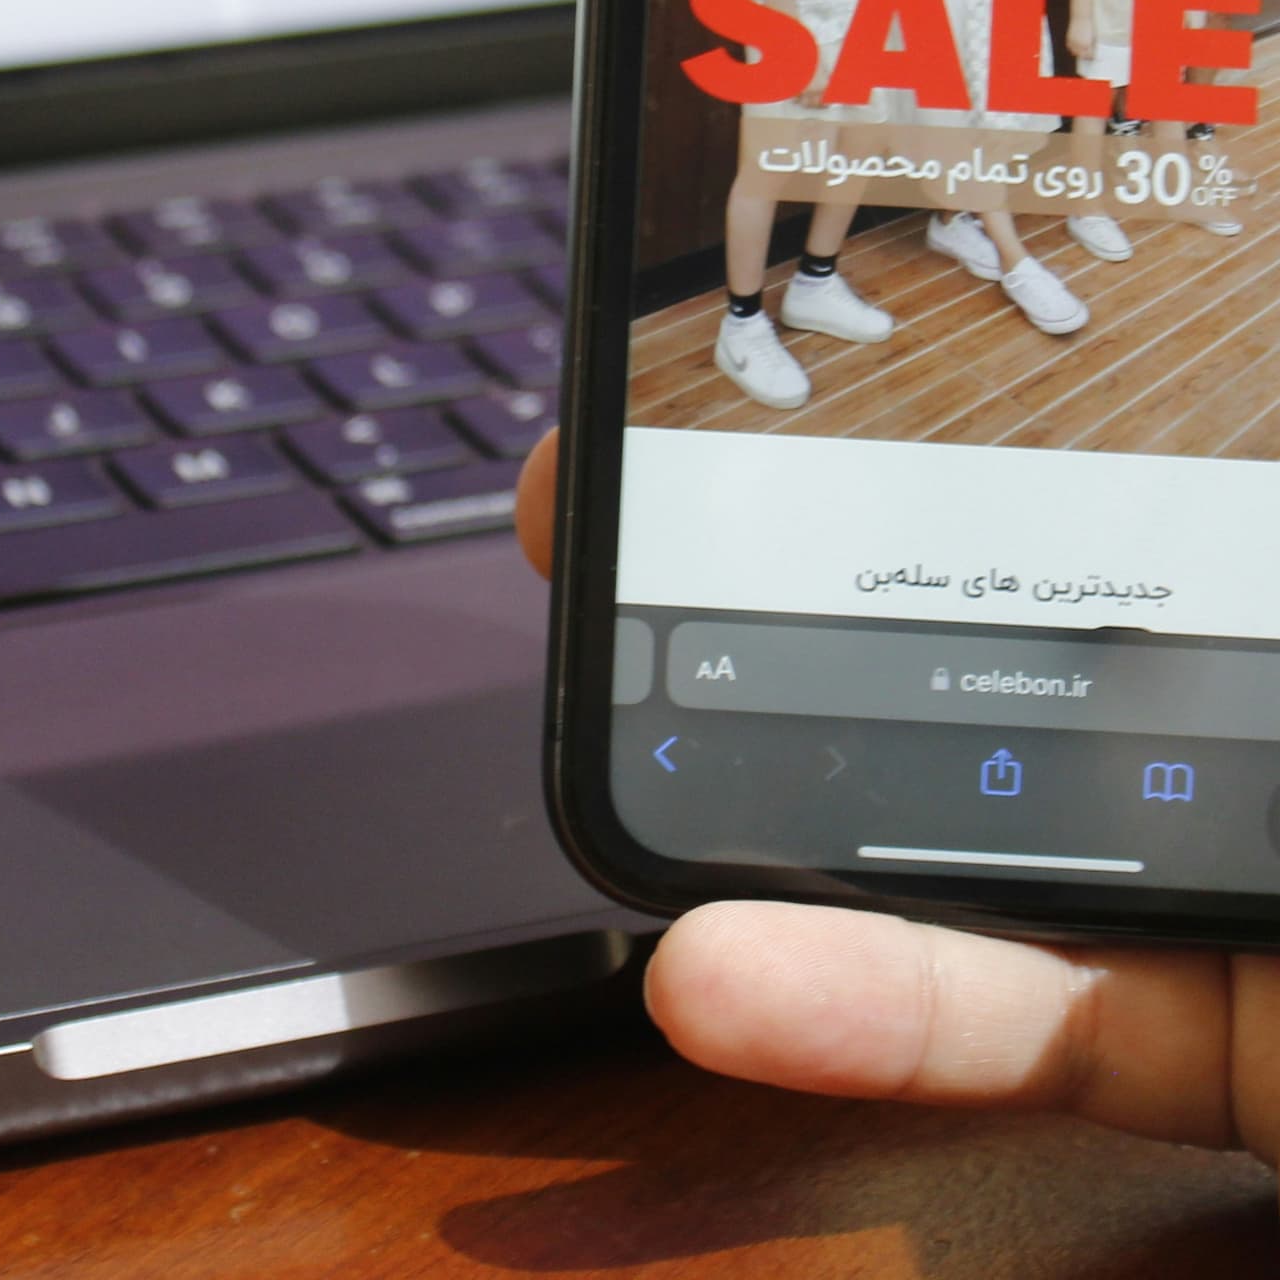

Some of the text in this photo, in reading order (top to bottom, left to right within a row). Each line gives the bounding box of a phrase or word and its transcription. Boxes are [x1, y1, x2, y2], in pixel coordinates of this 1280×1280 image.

[758, 138, 941, 188] محصولات
[946, 145, 1030, 195] تمام
[1032, 165, 1104, 199] روی
[1191, 185, 1239, 207] OFF
[962, 568, 1020, 598] های
[959, 670, 1094, 698] celebon.ir
